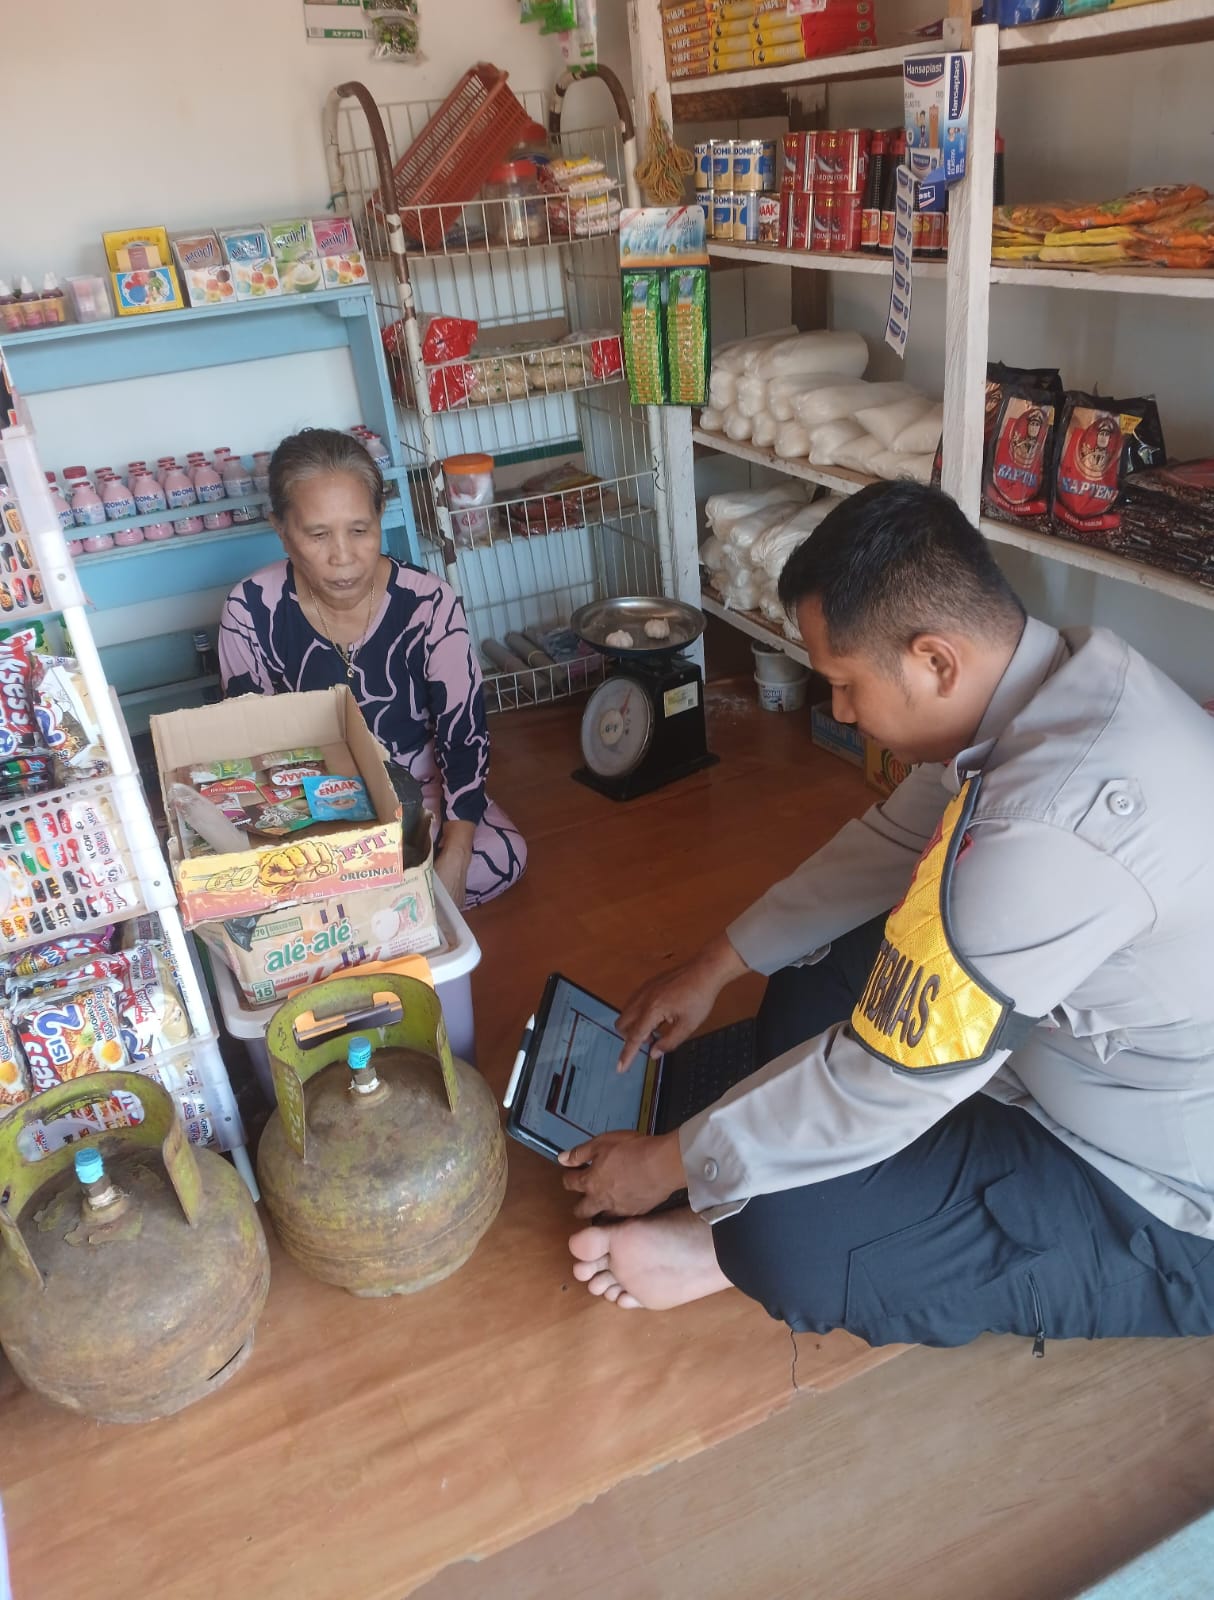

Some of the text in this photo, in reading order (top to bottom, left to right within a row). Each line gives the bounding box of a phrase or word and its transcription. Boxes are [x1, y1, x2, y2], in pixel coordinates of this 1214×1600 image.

[906, 62, 942, 76] Hansaplast
[951, 59, 961, 117] Hansaplast
[734, 146, 763, 156] DOMILK
[319, 780, 358, 797] ENAAK
[340, 866, 397, 882] ORIGINAL
[267, 917, 351, 973] alé-alé
[257, 985, 273, 997] 15
[37, 1004, 82, 1036] 2
[49, 1038, 69, 1063] ISI
